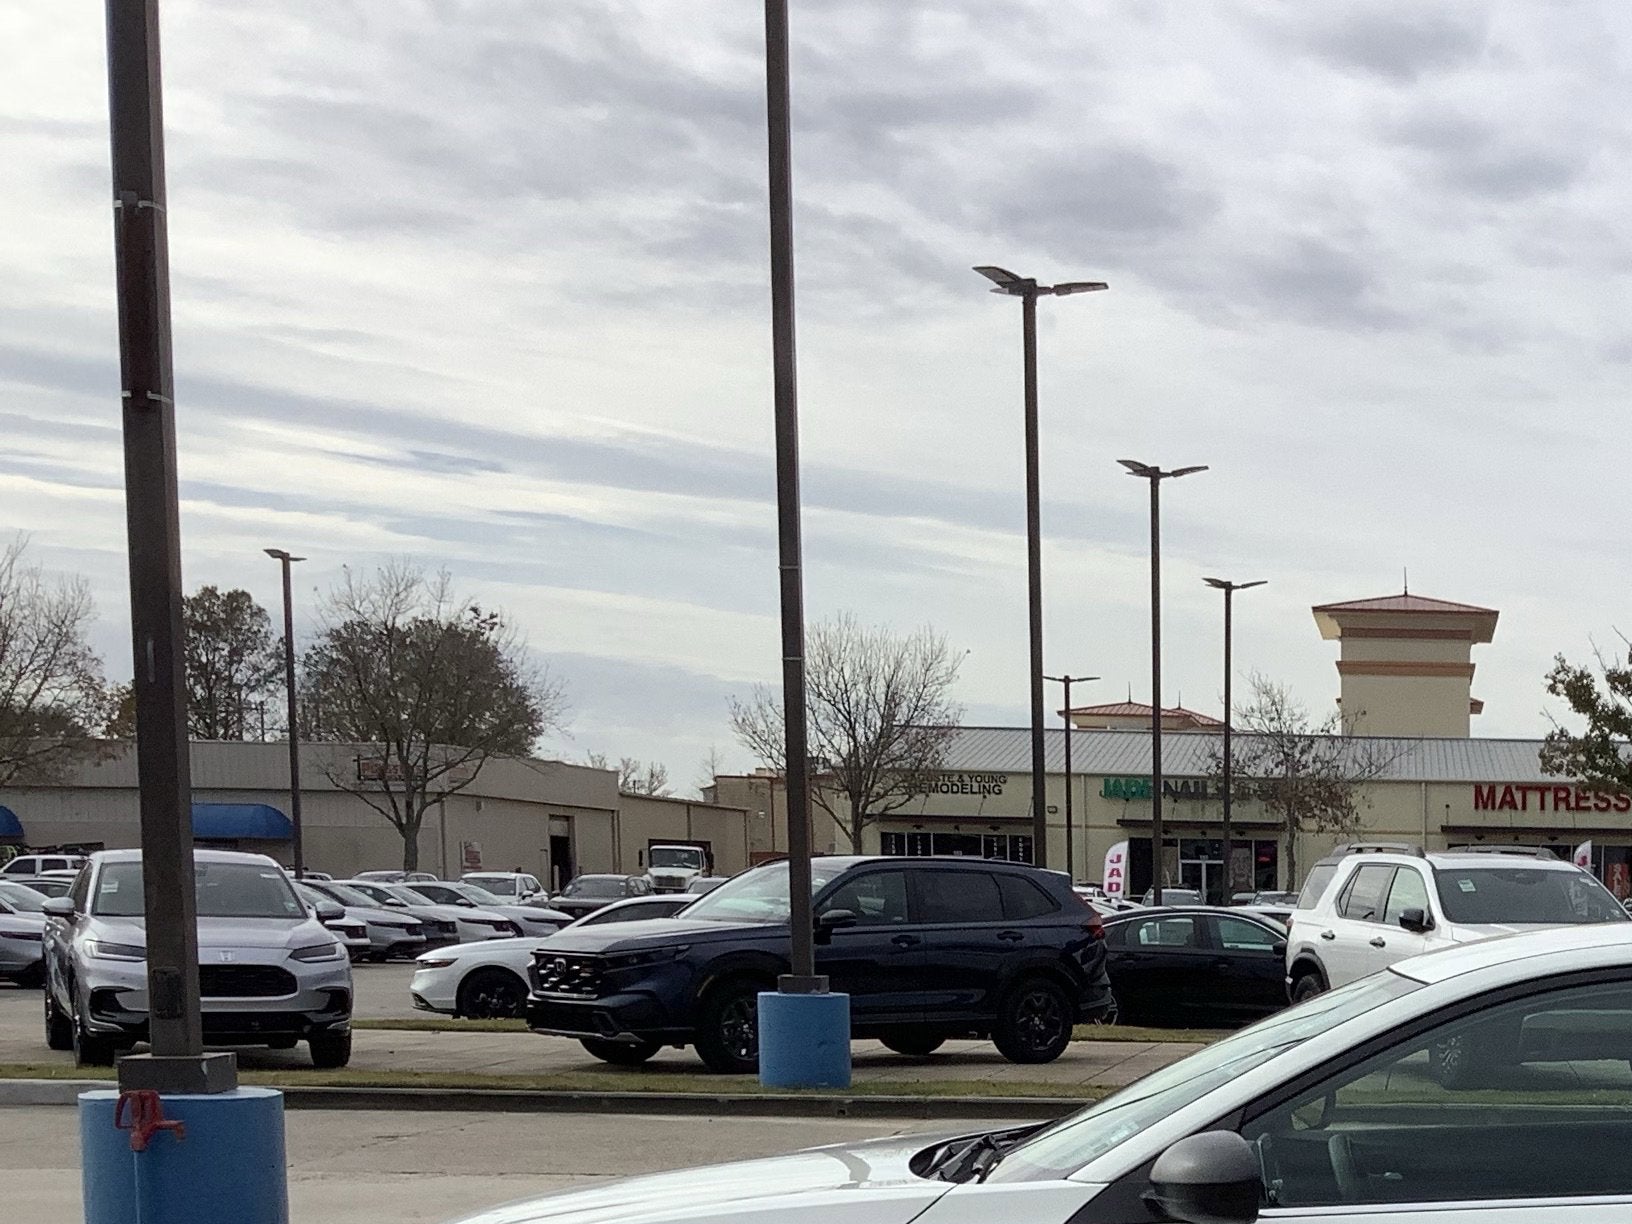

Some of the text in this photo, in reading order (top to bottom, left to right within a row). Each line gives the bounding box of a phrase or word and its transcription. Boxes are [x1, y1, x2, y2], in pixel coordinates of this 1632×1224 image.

[968, 774, 1008, 784] YOUNG
[908, 783, 1002, 795] REMODELING
[1473, 785, 1631, 812] MATTRESS
